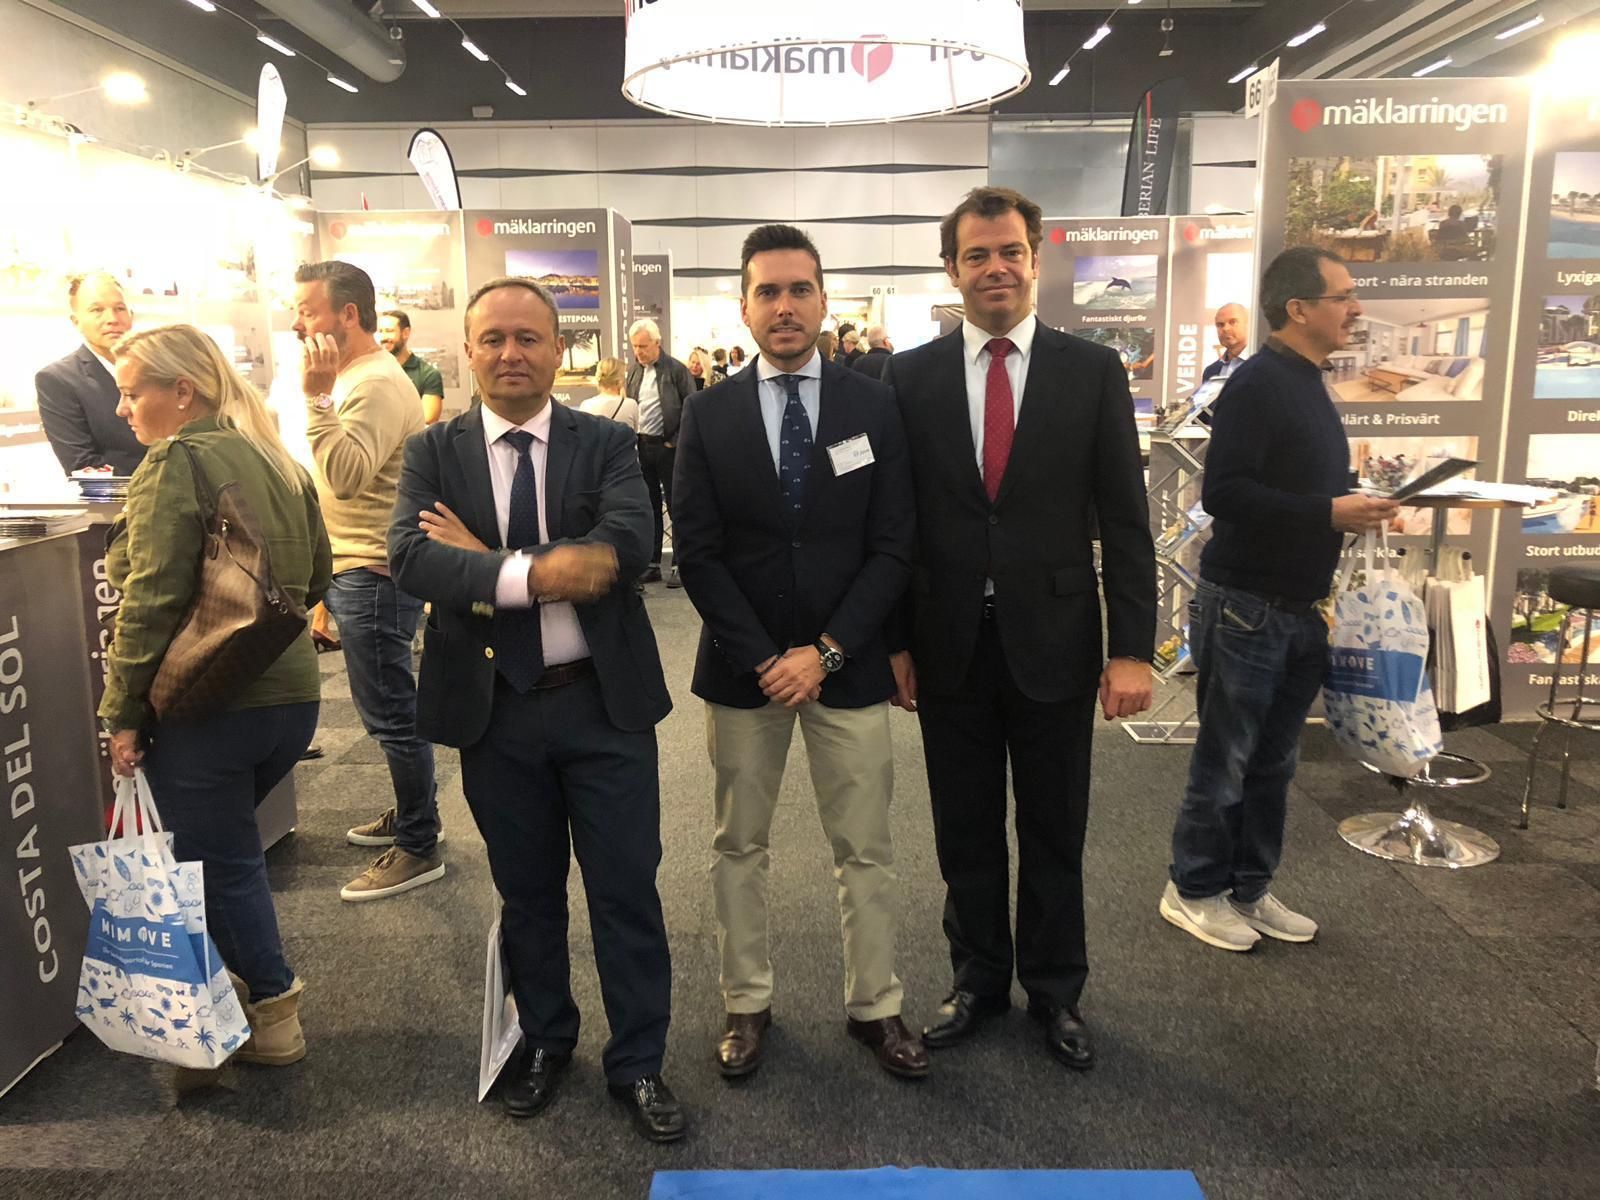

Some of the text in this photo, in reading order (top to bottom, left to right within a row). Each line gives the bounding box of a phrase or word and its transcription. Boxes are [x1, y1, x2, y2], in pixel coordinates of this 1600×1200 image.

[1249, 79, 1262, 109] 66
[1323, 97, 1508, 131] mäklarringen
[1145, 118, 1161, 155] LIFE
[494, 219, 596, 237] mäklarringen
[1066, 226, 1159, 244] mäklarringen
[1389, 275, 1422, 287] nära
[1424, 273, 1489, 286] stranden
[872, 287, 881, 295] 60
[886, 287, 895, 295] 61
[1082, 315, 1122, 323] Fantastiskt
[1176, 323, 1199, 394] VERDE
[1372, 414, 1383, 425] &
[1386, 413, 1440, 425] Prisvärt
[1525, 545, 1561, 557] Stort
[0, 615, 59, 983] COSTA DEL SOL
